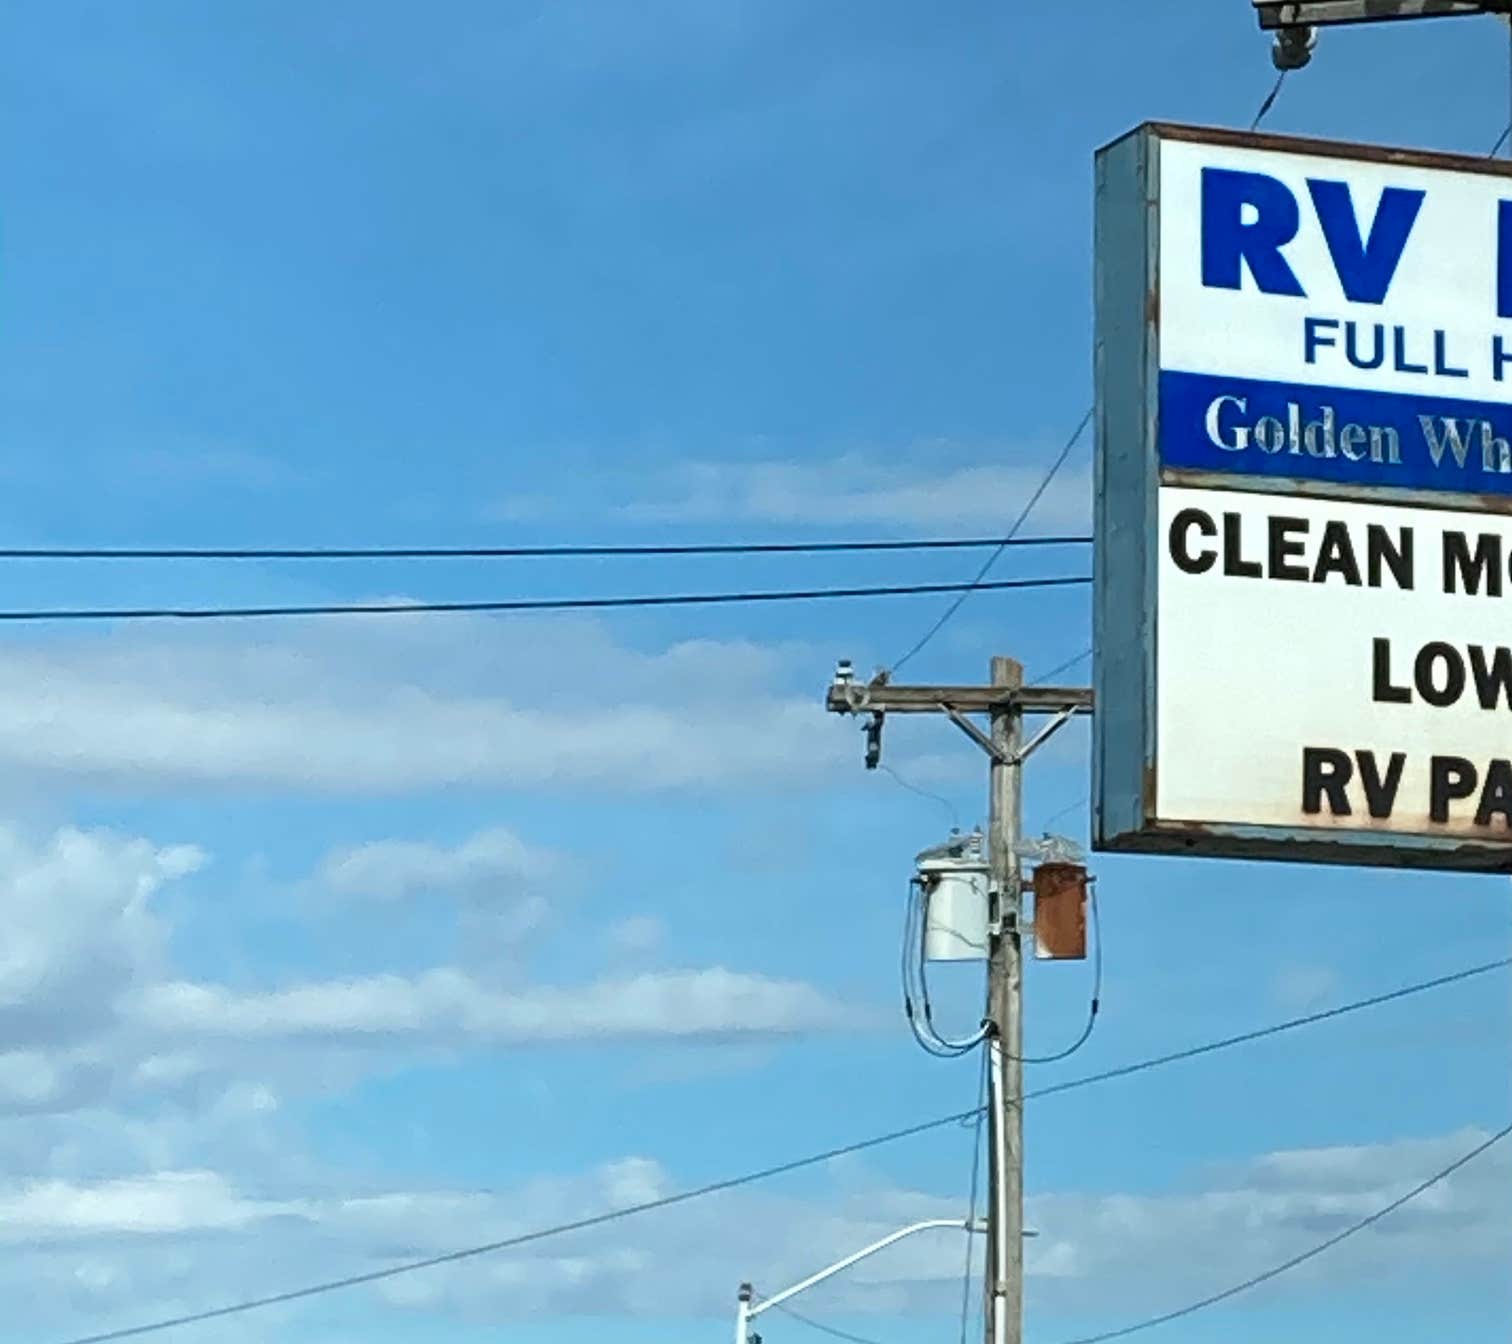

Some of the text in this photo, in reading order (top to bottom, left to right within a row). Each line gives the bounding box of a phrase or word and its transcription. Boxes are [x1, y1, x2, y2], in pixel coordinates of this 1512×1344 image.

[1200, 165, 1426, 306] RV
[1301, 315, 1469, 380] FULL
[1204, 394, 1402, 466] Golden
[1167, 506, 1416, 591] CLEAN
[1301, 746, 1406, 820] RV
